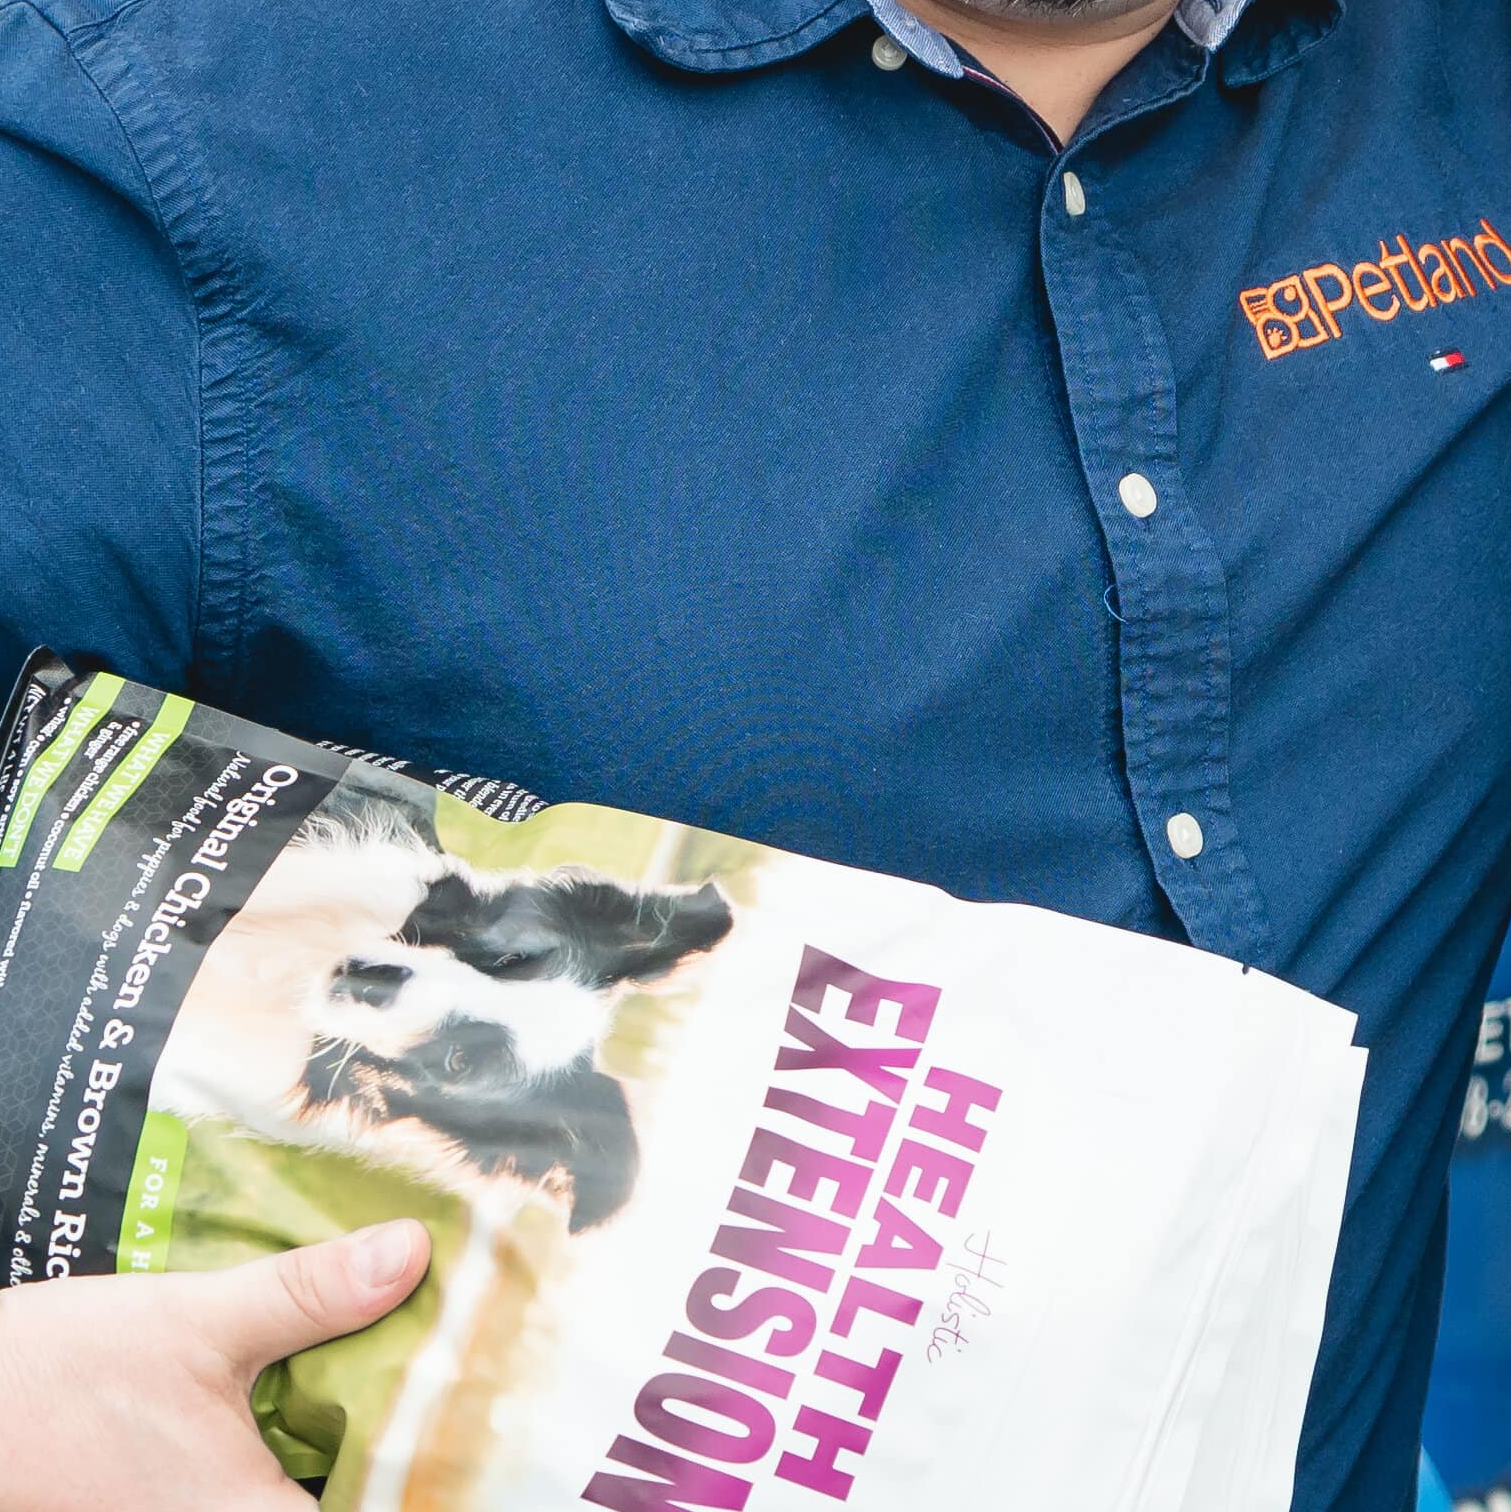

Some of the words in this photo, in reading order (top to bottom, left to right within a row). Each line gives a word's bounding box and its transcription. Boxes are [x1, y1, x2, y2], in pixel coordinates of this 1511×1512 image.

[54, 706, 100, 760] WHAT
[93, 744, 122, 774] range
[121, 731, 172, 784] WHAT
[29, 759, 56, 788] WE
[63, 771, 101, 812] chicken
[97, 782, 132, 810] WE
[204, 750, 252, 802] Natural
[63, 808, 108, 862] HAVE
[166, 819, 197, 842] for
[183, 796, 218, 825] food
[190, 764, 299, 871] Original
[34, 818, 65, 871] coconut
[132, 837, 172, 898] puppies
[2, 900, 32, 958] flavored
[102, 913, 134, 952] dogs
[112, 872, 211, 1010] Chicken
[86, 953, 110, 995] with
[66, 996, 95, 1053] added
[98, 1018, 135, 1050] &
[58, 1059, 123, 1201] Brown
[17, 1142, 49, 1227] minerals
[139, 1155, 168, 1210] FOR
[135, 1220, 155, 1239] A
[775, 1064, 1005, 1504] HEALTH
[926, 1229, 1006, 1366] Holistic
